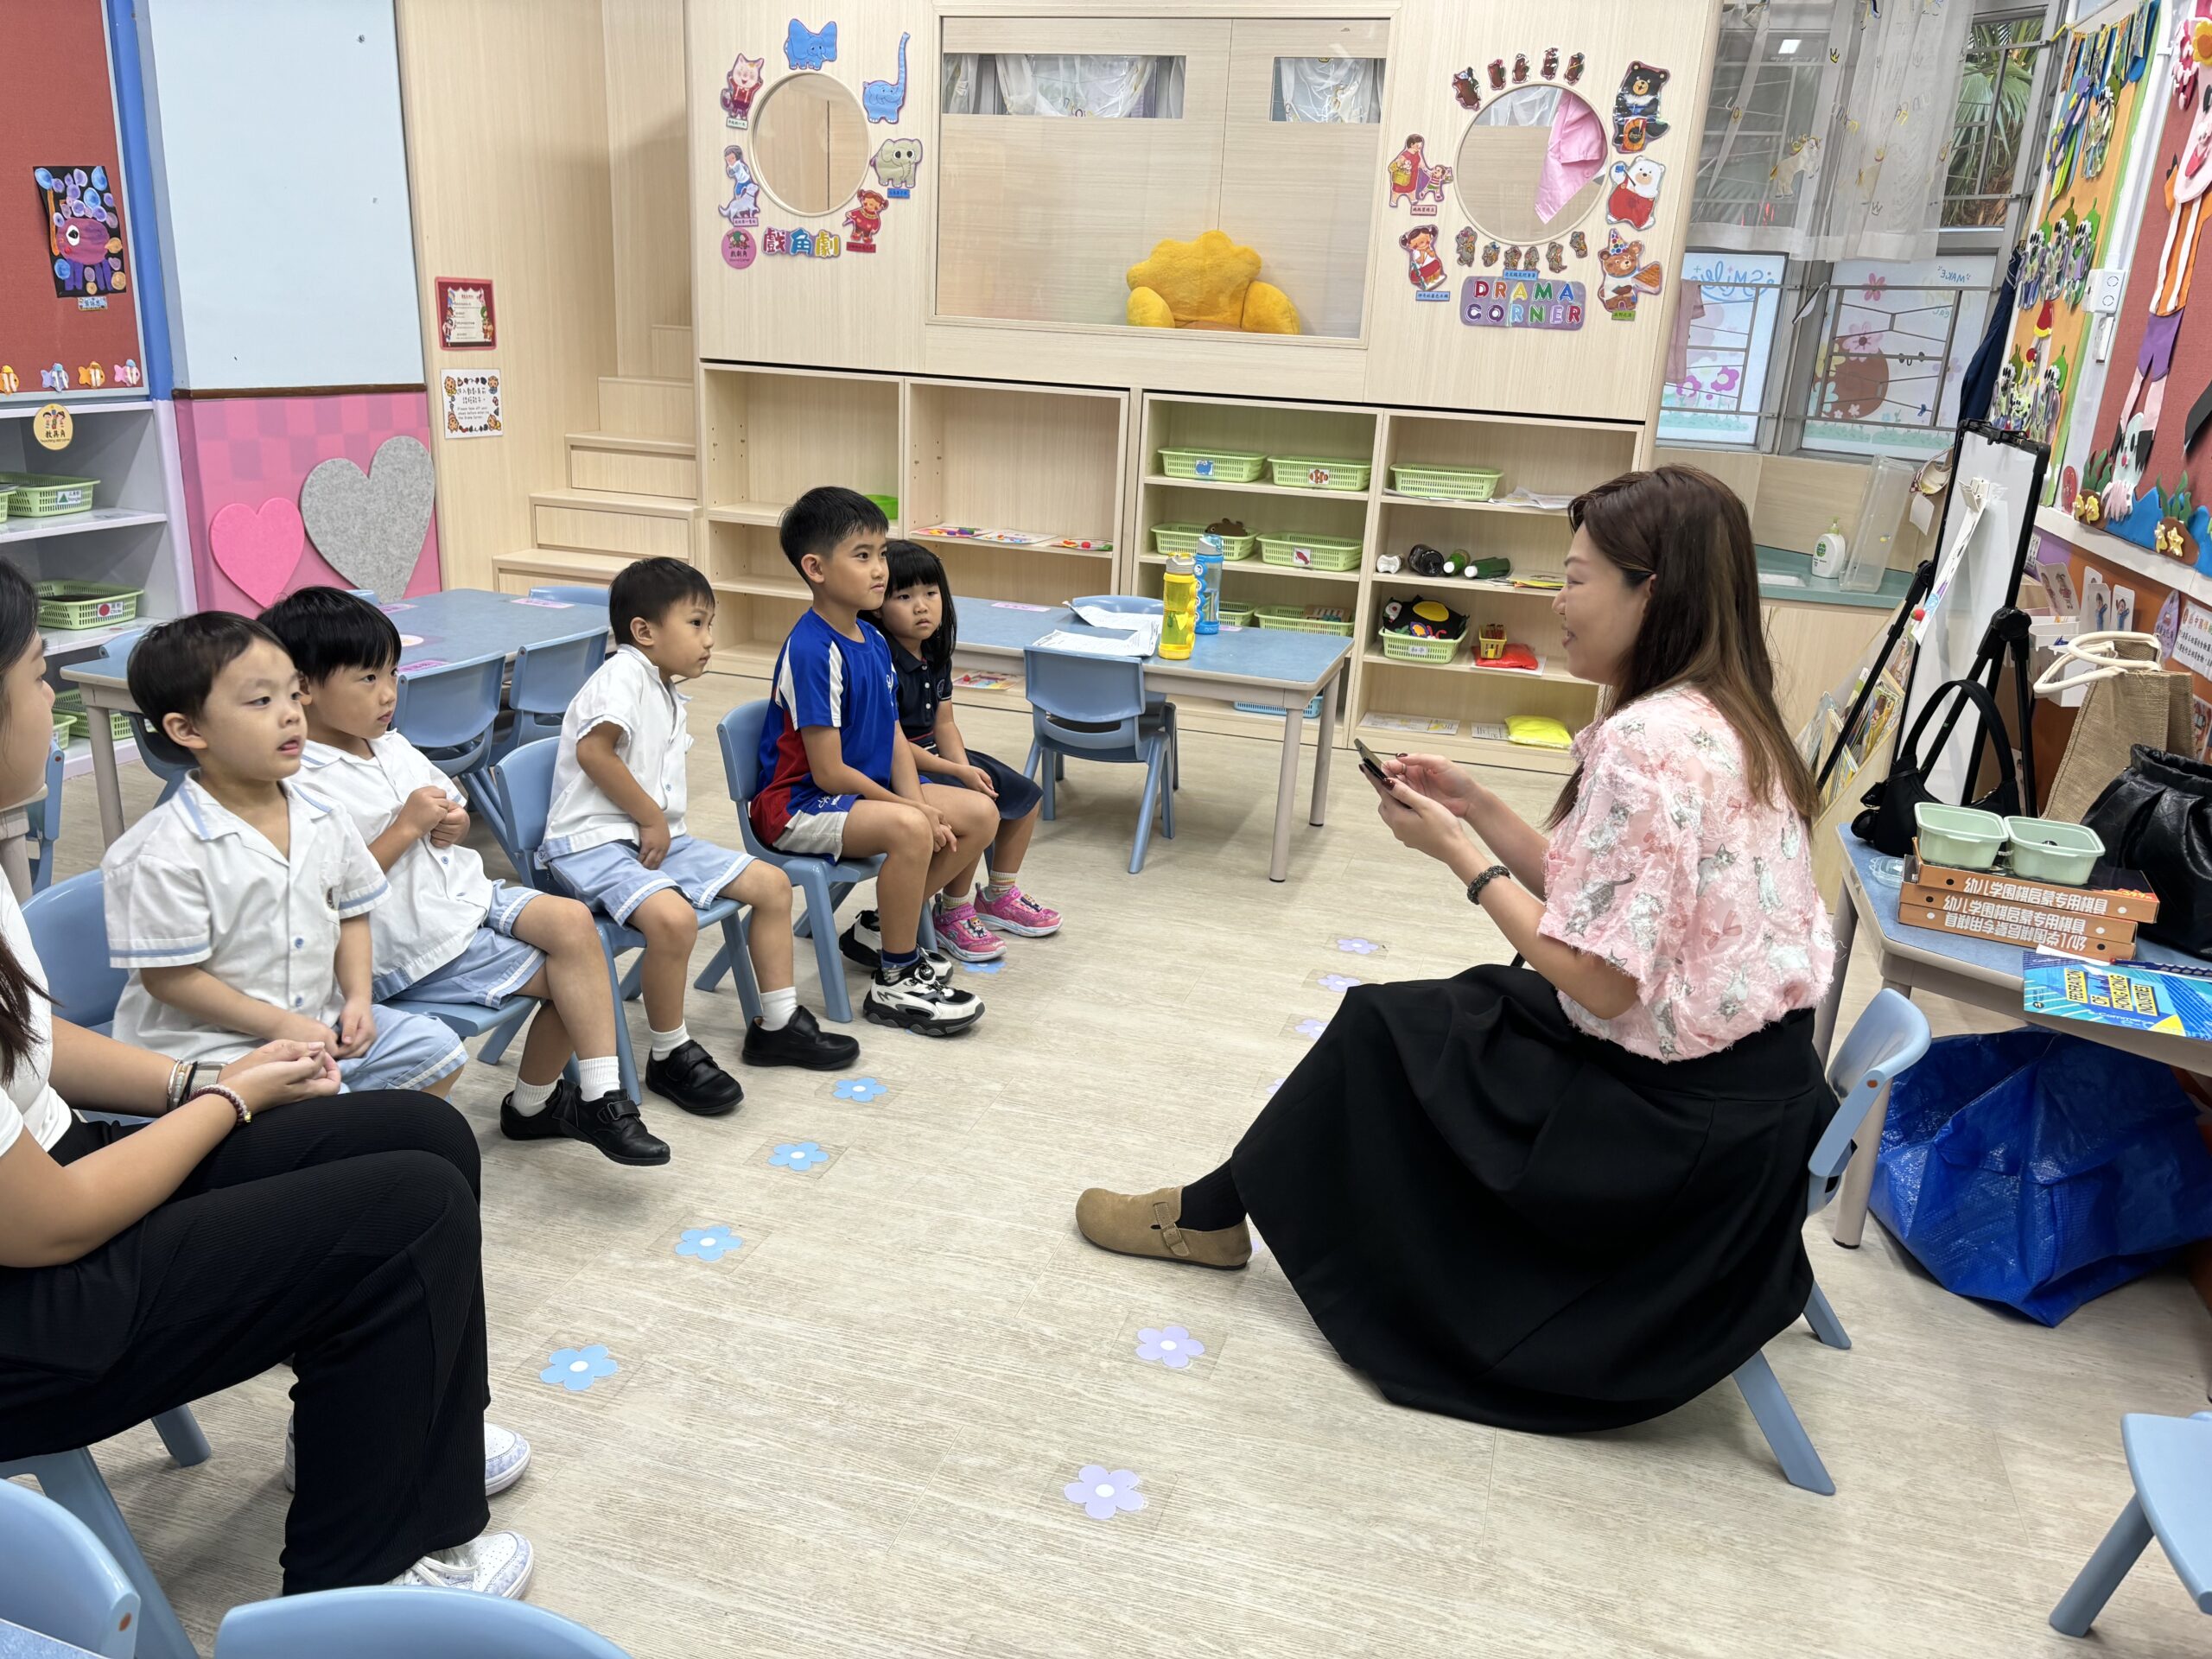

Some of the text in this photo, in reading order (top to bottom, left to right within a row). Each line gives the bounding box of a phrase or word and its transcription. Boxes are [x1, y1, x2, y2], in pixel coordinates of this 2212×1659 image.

[764, 227, 839, 257] 戲角劇
[1474, 280, 1574, 302] DRAMA
[1465, 303, 1582, 324] CORNER
[1963, 877, 2108, 915] 幼儿学围棋启蒙专用棋具
[1943, 894, 2087, 935] 幼儿学围棋启蒙专用棋具
[2066, 969, 2085, 1002] FEDERATION
[2091, 995, 2107, 1005] OF
